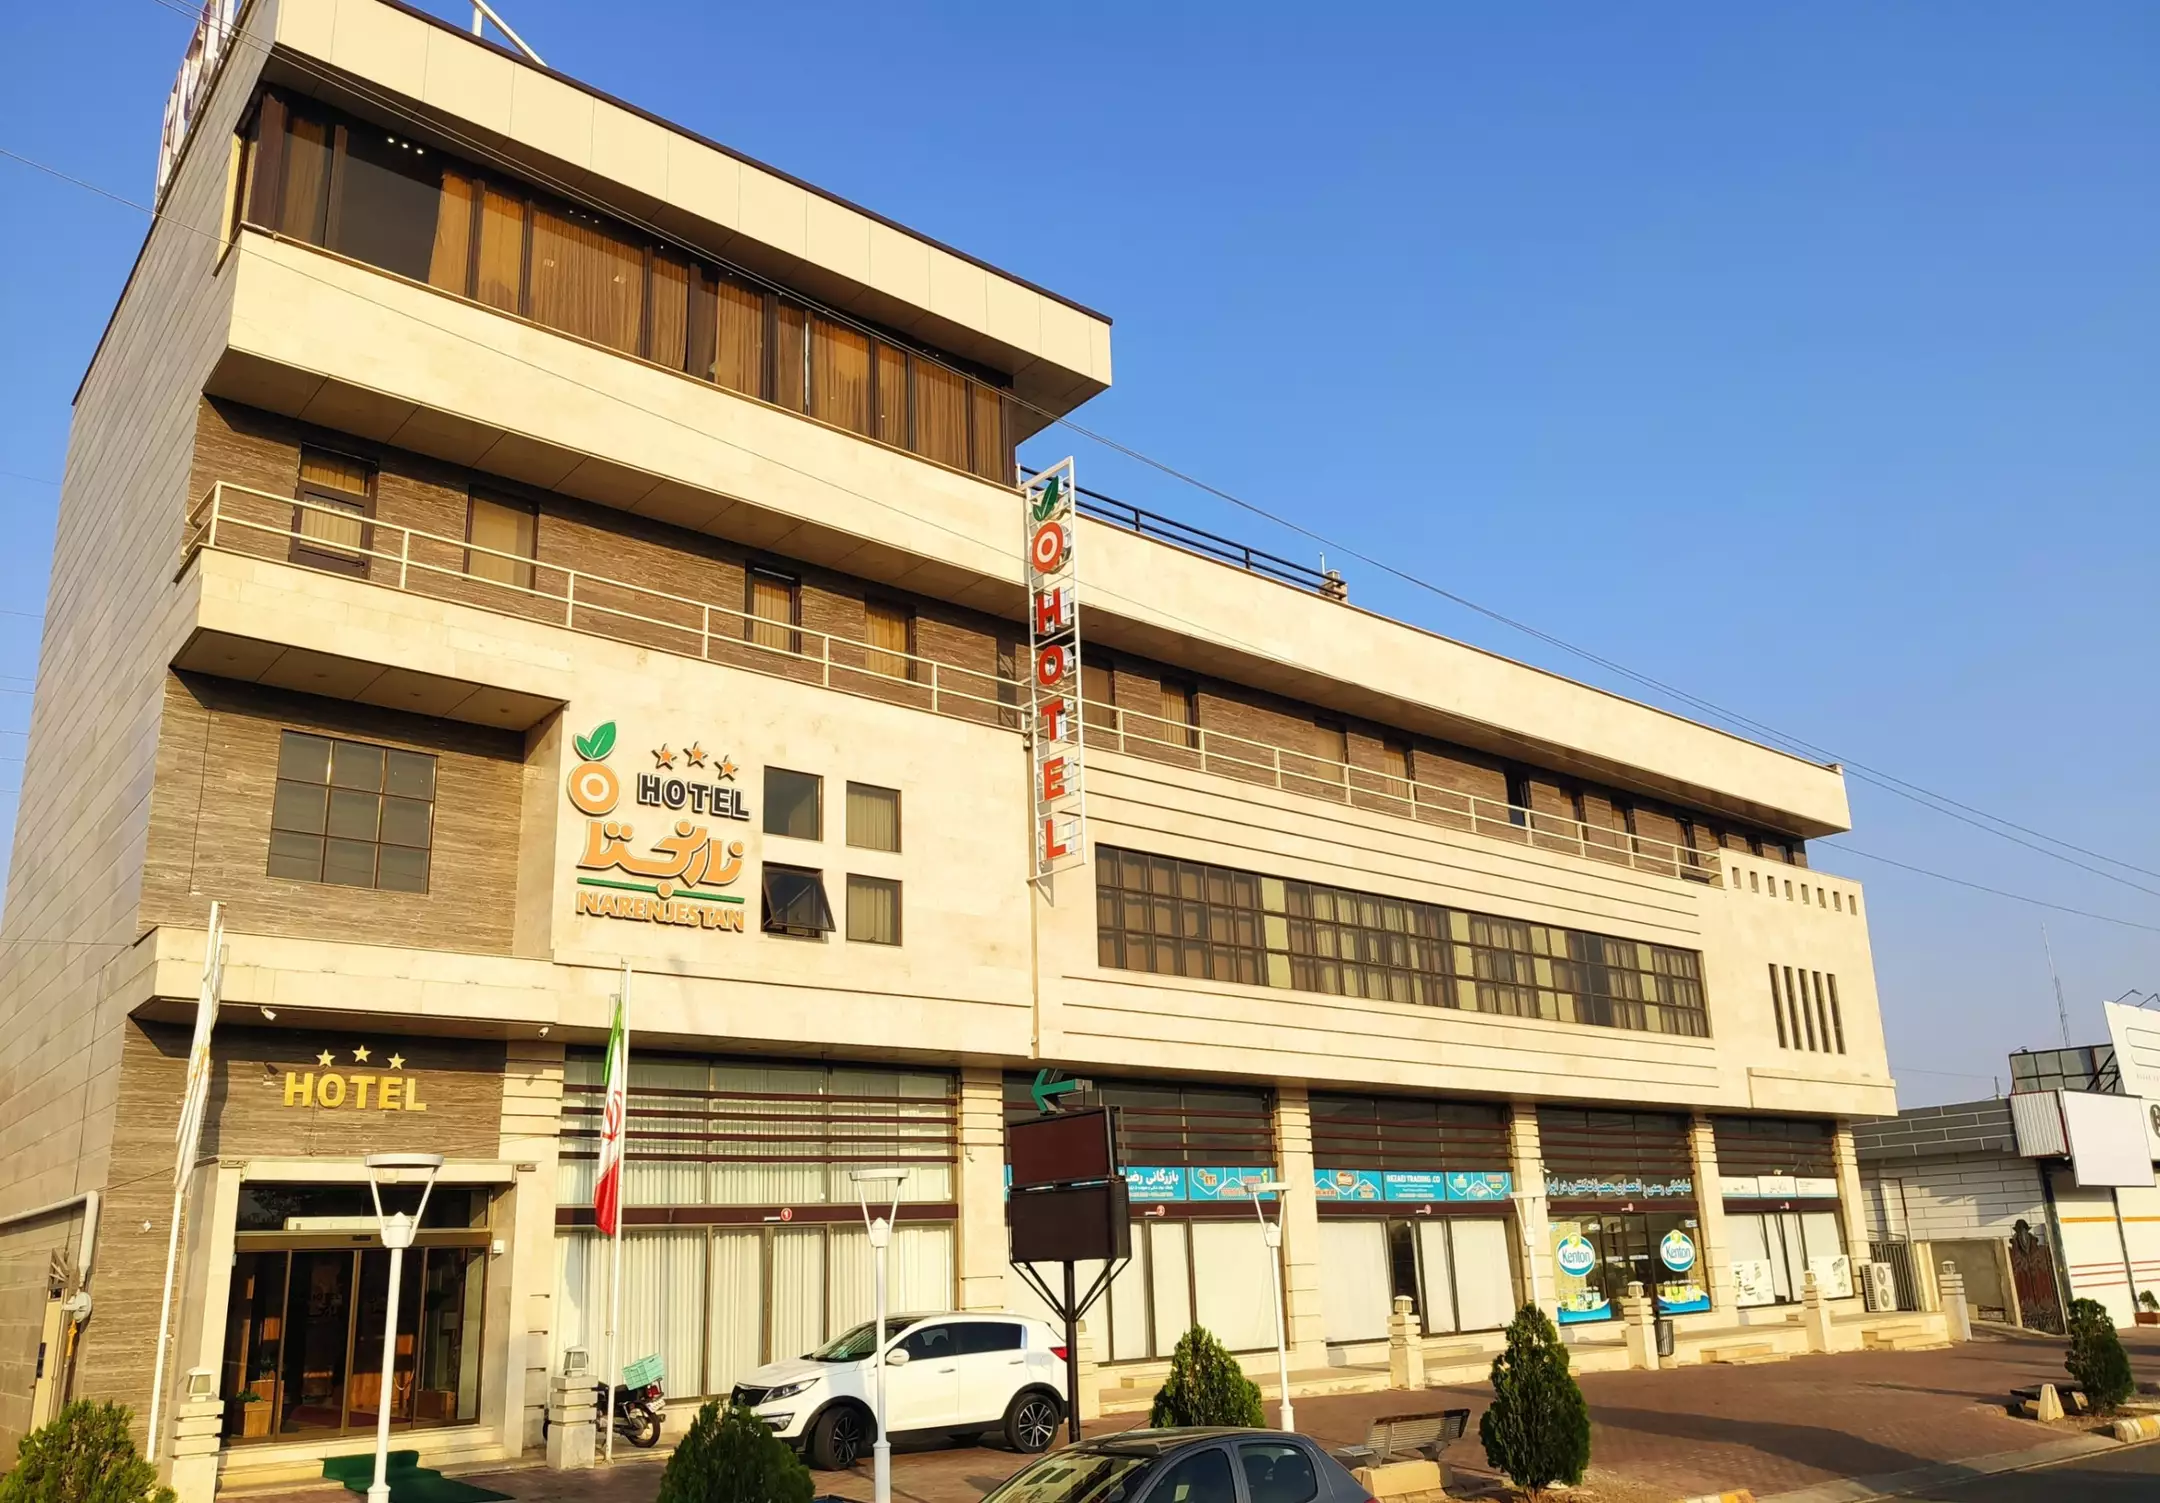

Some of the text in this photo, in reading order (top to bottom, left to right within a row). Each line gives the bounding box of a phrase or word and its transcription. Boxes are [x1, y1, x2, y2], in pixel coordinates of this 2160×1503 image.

[1035, 586, 1068, 860] HOTEL
[637, 773, 750, 820] HOTEL
[576, 891, 744, 932] NARENJESTAN
[283, 1072, 427, 1111] HOTEL
[1145, 1168, 1179, 1185] بازرگانی
[1615, 1177, 1642, 1197] انحصاری
[1647, 1183, 1665, 1196] رسمی
[1666, 1177, 1692, 1196] نمایندگی
[1562, 1250, 1591, 1264] Kenton
[1665, 1245, 1691, 1258] Kenton
